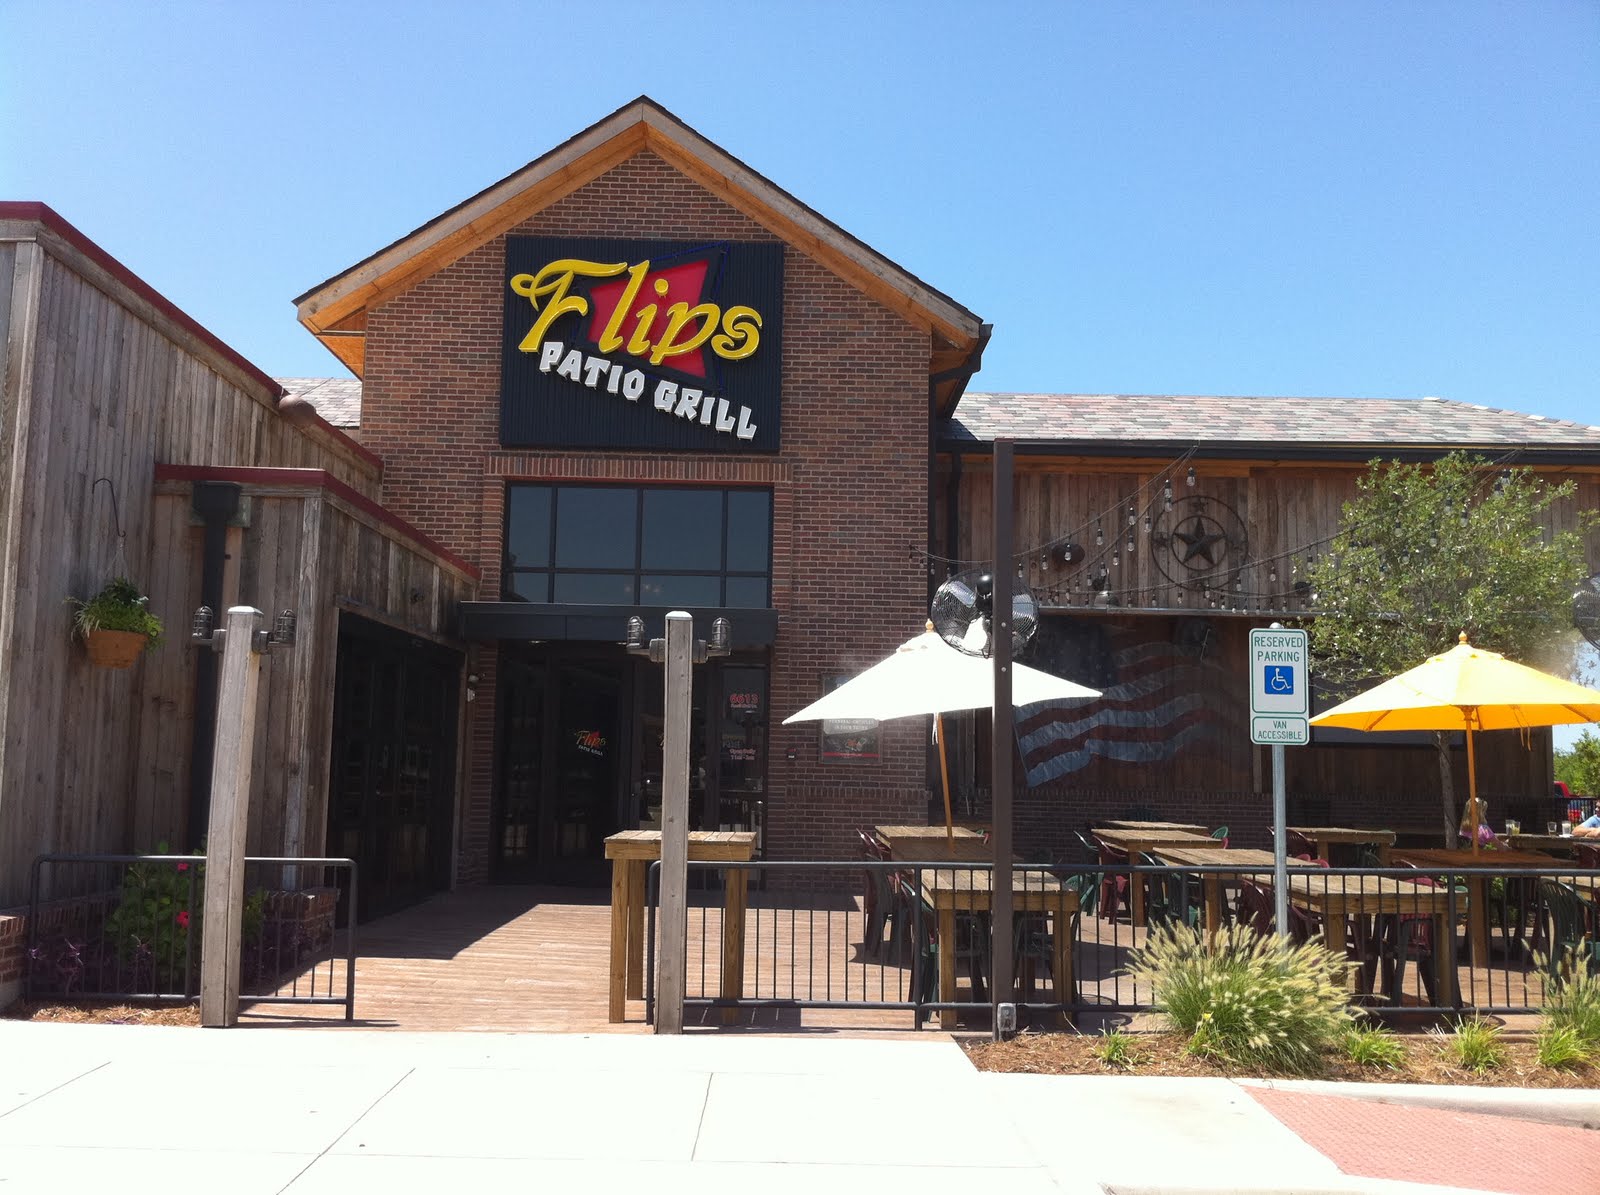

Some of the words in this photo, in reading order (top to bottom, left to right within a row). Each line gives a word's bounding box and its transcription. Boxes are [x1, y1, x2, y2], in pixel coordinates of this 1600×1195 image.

[510, 258, 763, 366] Flips
[539, 341, 645, 402] PATIO
[654, 380, 758, 440] GRILL
[1254, 636, 1303, 648] RESERVED
[1257, 650, 1300, 662] PARKING
[1272, 720, 1287, 729] VAN
[1257, 730, 1302, 740] ACCESSIBLE
